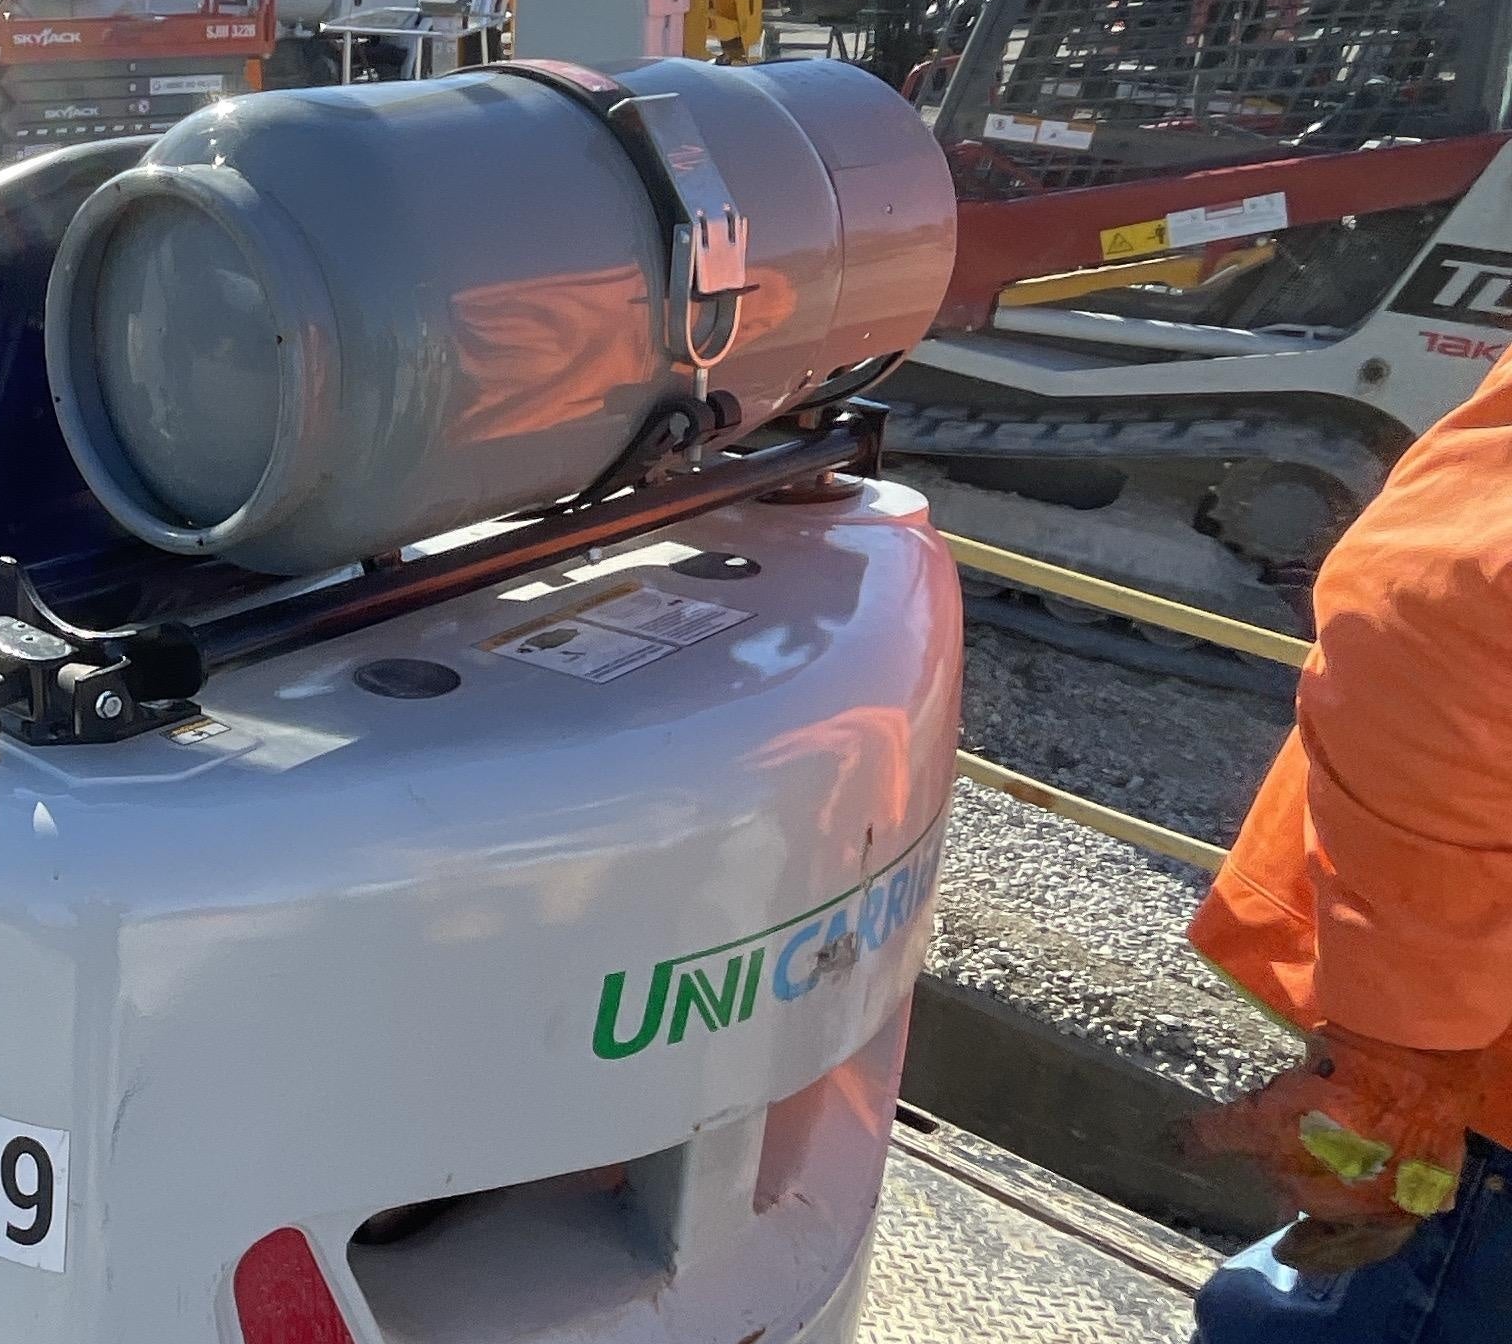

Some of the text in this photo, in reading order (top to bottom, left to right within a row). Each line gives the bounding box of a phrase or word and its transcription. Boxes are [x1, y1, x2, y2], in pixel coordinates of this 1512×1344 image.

[12, 27, 81, 46] SKYJACK
[44, 106, 102, 120] SKYJACK
[592, 831, 940, 1060] UNICARRI
